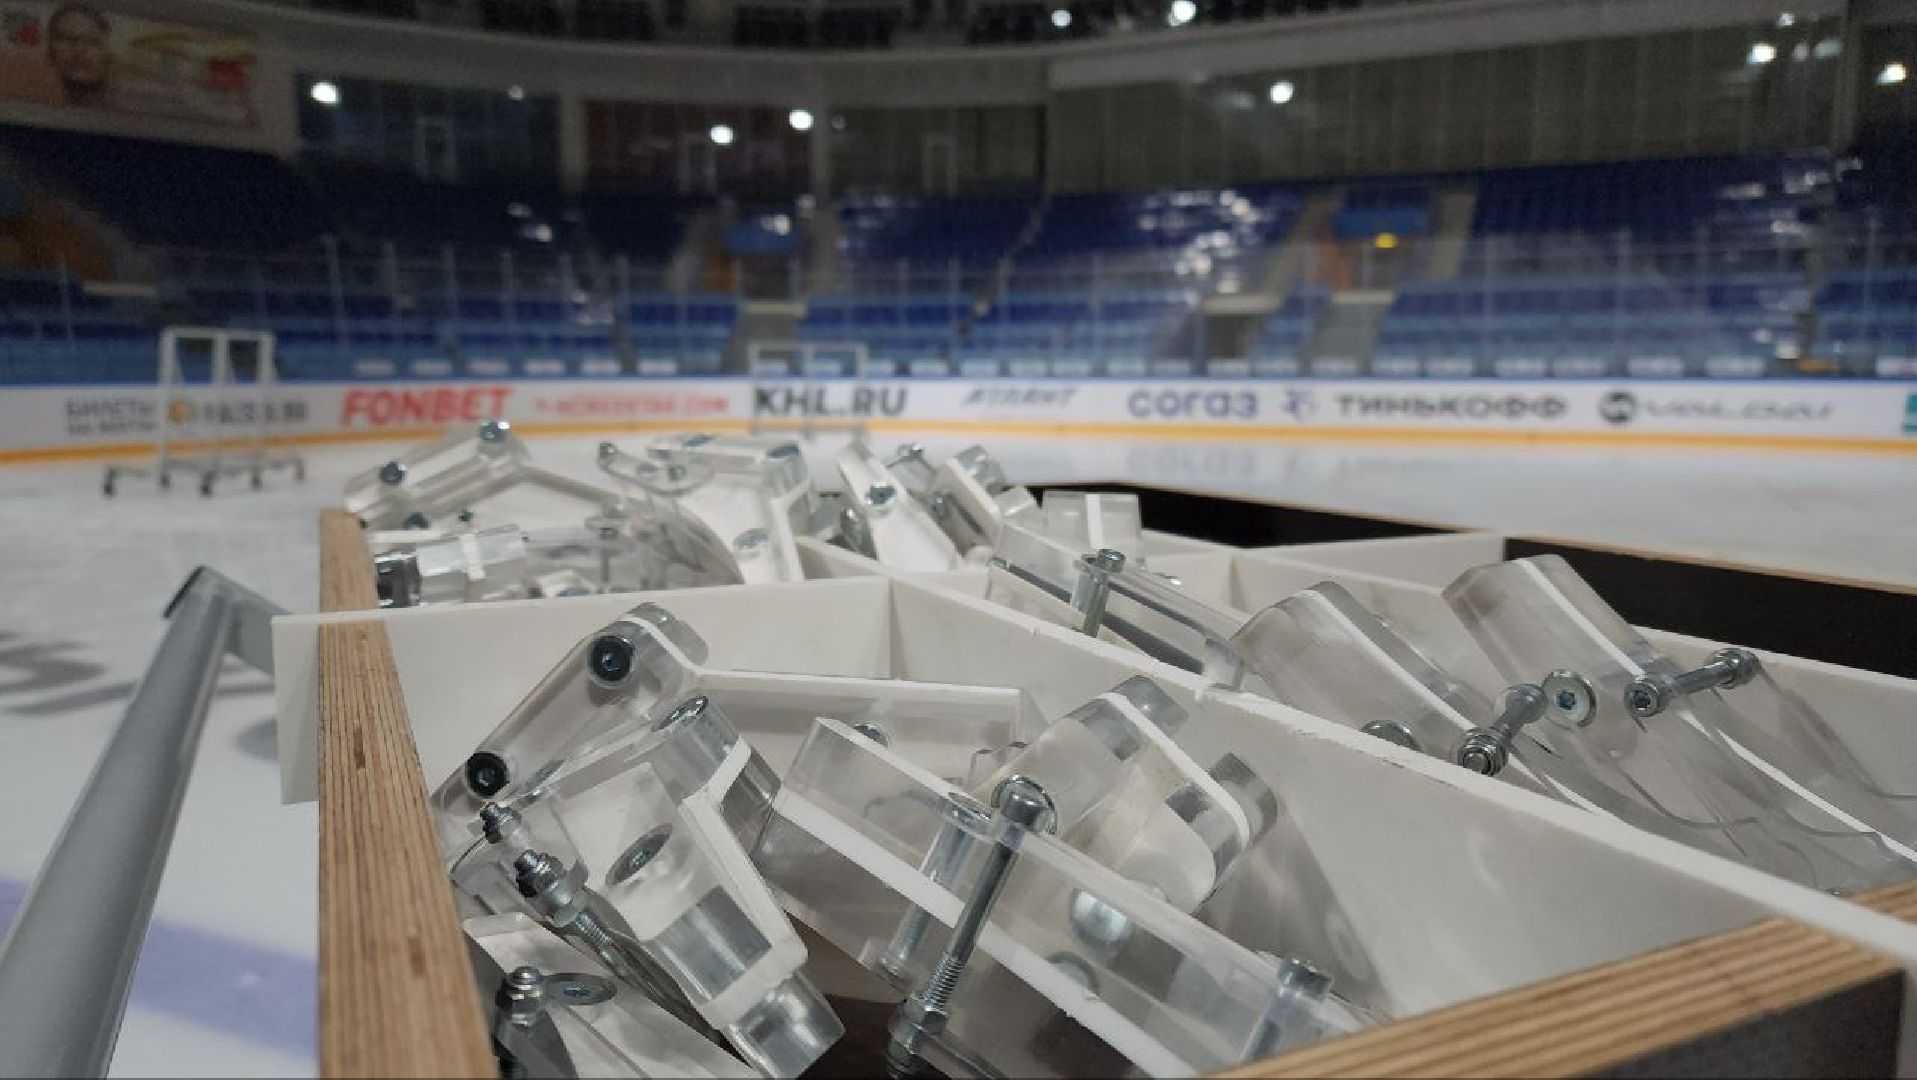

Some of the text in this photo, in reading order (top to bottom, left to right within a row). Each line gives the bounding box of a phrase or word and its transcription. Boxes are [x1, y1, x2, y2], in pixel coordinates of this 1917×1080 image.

[342, 386, 513, 425] FONBET
[754, 387, 908, 417] KHL.RU
[1335, 393, 1568, 420] ТИНЬКОФФ
